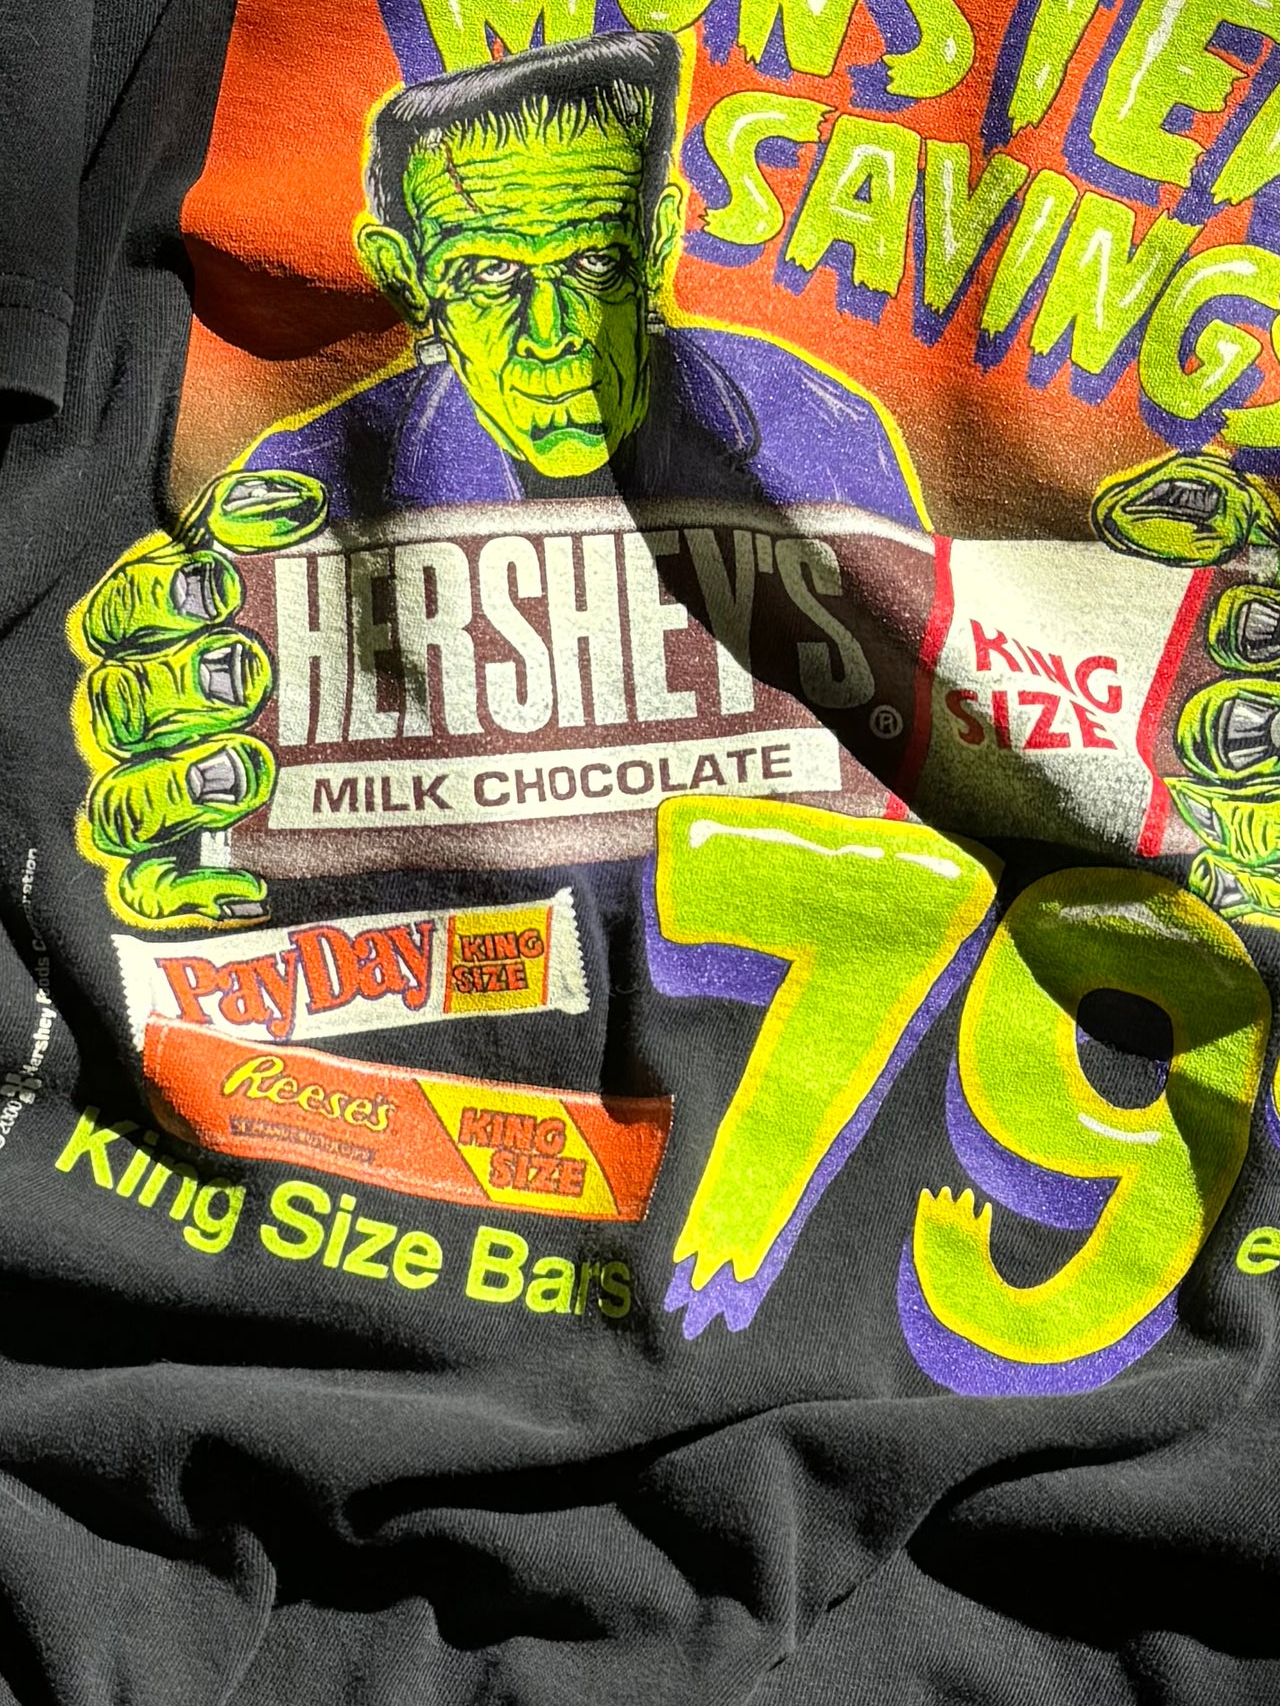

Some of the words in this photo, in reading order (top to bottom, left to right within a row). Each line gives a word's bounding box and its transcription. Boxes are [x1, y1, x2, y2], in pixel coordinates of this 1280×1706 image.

[271, 529, 877, 749] HERSHEY'S
[969, 618, 1123, 716] KING
[945, 689, 1118, 752] SIZE
[312, 771, 451, 817] MILK
[472, 744, 793, 807] CHOCOLATE
[156, 920, 438, 1043] PayDay
[451, 962, 530, 993] SIZE
[458, 928, 546, 964] KING
[222, 1055, 398, 1132] Reese's
[457, 1106, 567, 1156] KING
[488, 1149, 588, 1199] SIZE
[55, 1106, 246, 1254] King
[260, 1179, 444, 1290] Size
[465, 1223, 633, 1319] Bars
